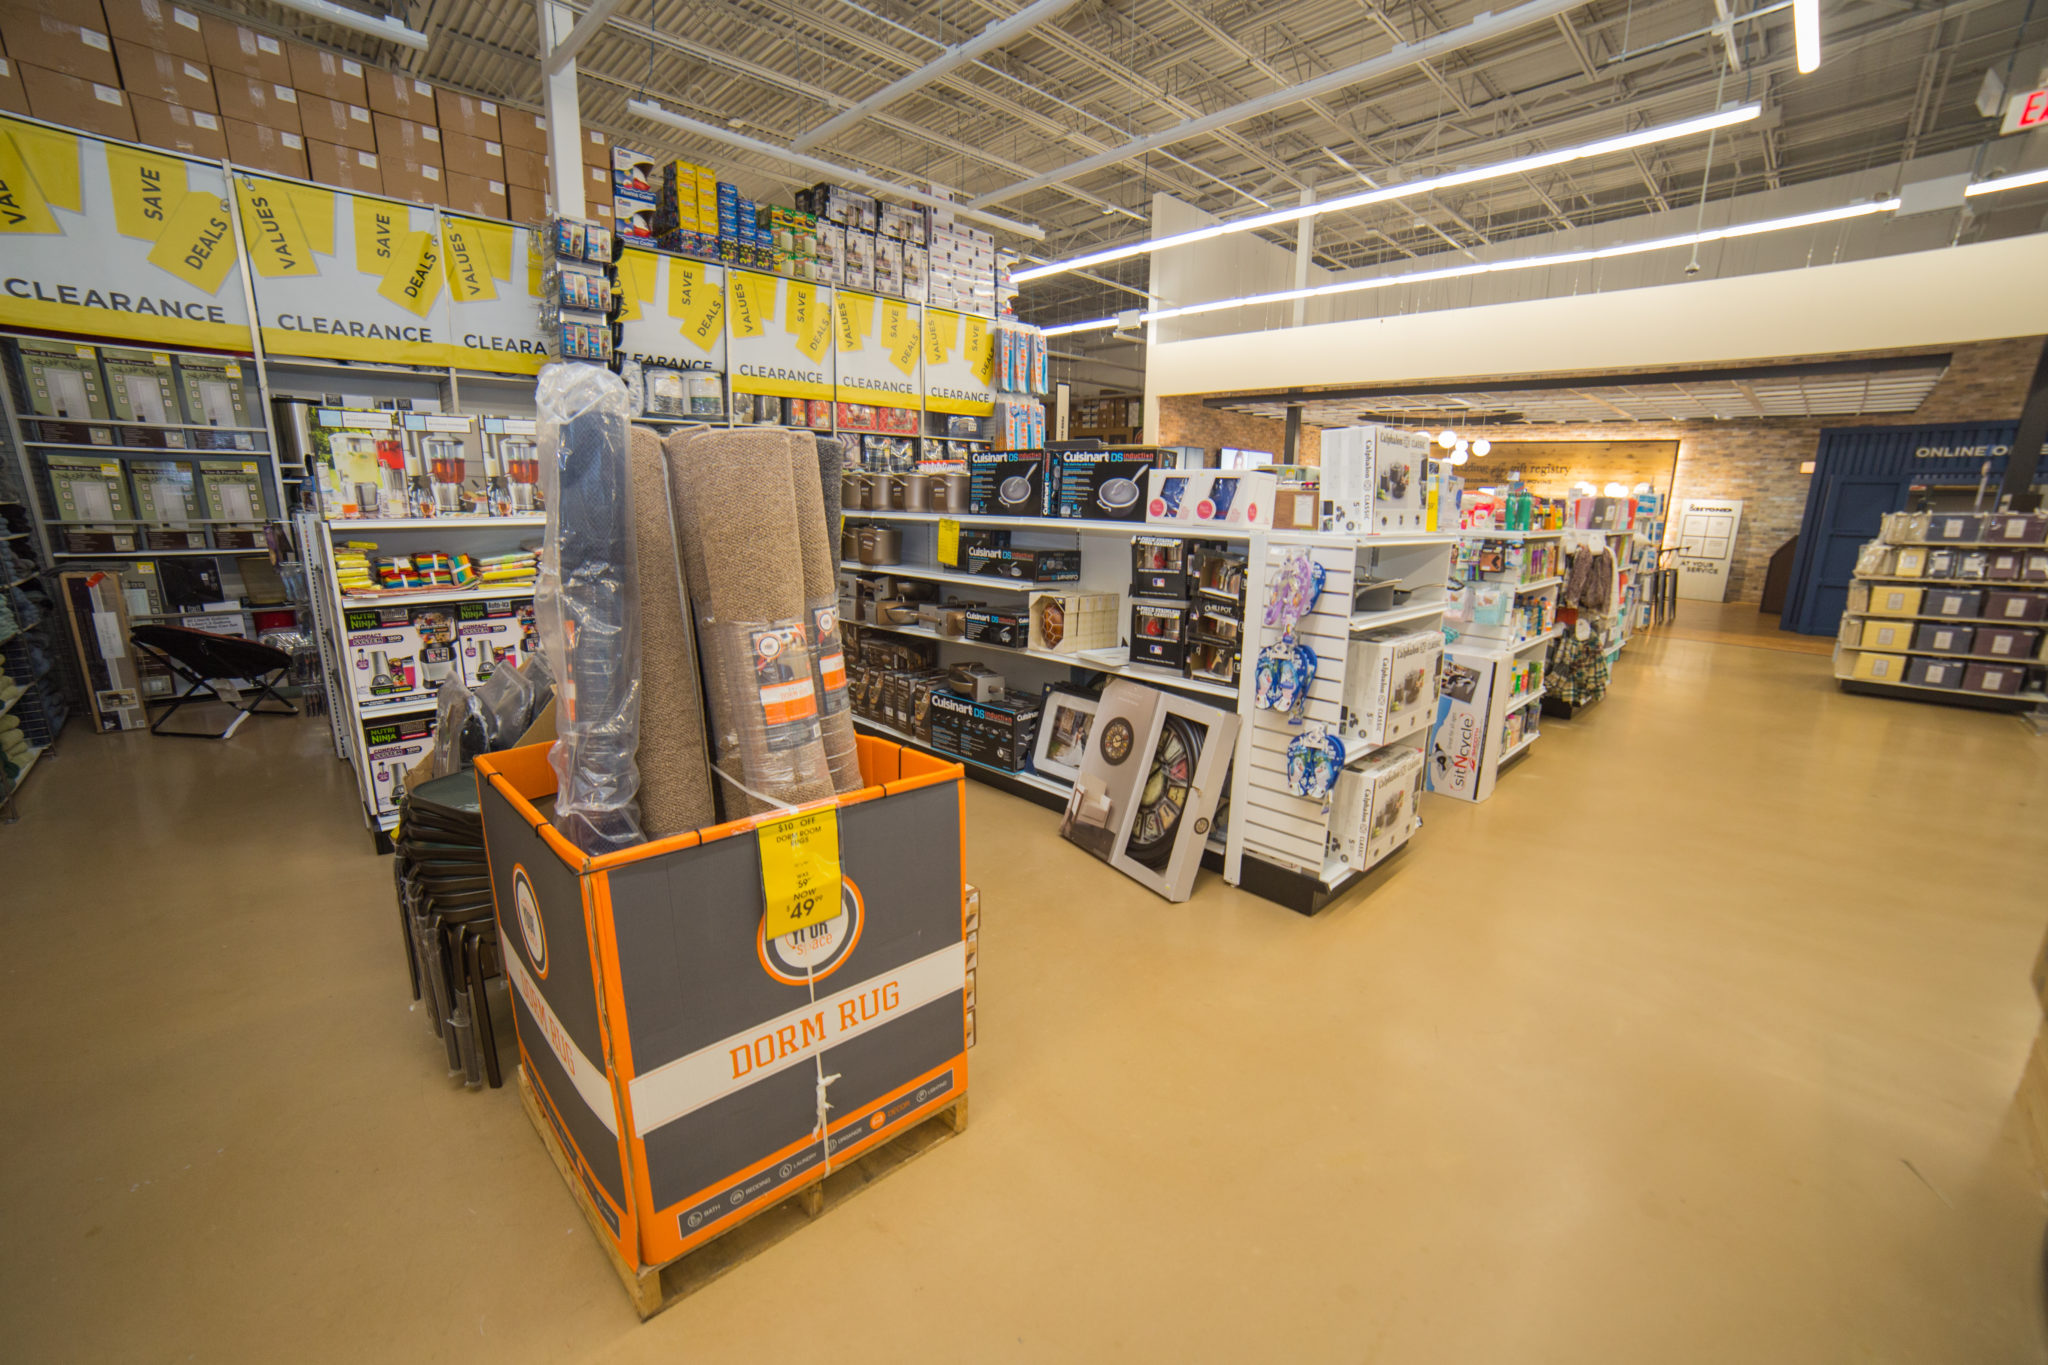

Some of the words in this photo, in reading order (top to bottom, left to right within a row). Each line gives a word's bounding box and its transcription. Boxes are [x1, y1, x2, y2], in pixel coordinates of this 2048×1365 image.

[140, 167, 163, 221] SAVE
[184, 218, 228, 270] DEALS
[252, 197, 296, 269] VALUES
[376, 214, 390, 258] SAVE
[404, 252, 437, 298] DEALS
[451, 233, 480, 296] VALUES
[4, 278, 226, 324] CLEARANCE
[681, 270, 693, 305] SAVE
[698, 301, 722, 337] DEALS
[735, 284, 754, 333] VALUES
[797, 292, 806, 322] SAVE
[278, 314, 432, 343] CLEARANCE
[809, 319, 829, 351] DEALS
[839, 302, 853, 348] VALUES
[890, 310, 899, 338] SAVE
[464, 334, 548, 355] CLEARA
[901, 335, 918, 365] DEALS
[928, 320, 940, 360] VALUES
[740, 365, 823, 384] CLEARANCE
[980, 348, 994, 376] DEAL
[843, 376, 912, 394] CLEARANCE
[931, 387, 989, 403] CLEARANCE
[972, 452, 1008, 463] Cuisinart
[1009, 453, 1019, 462] DS
[1063, 451, 1109, 463] Cuisinart
[1110, 452, 1123, 462] DS
[1916, 446, 1985, 457] ONLINE
[1530, 464, 1569, 476] registry
[968, 546, 1001, 559] Cuisinart
[1003, 550, 1011, 559] DS
[351, 620, 377, 629] NINJA
[966, 612, 990, 622] Cuisinart
[1381, 658, 1389, 693] Calphalon
[932, 695, 972, 716] Cuisinart
[974, 707, 985, 719] DS
[1017, 711, 1039, 721] Cuisinar
[371, 727, 396, 735] NUTRI
[372, 734, 397, 744] NINJA
[1361, 789, 1371, 822] Calphalon
[778, 822, 794, 832] $10
[800, 817, 815, 826] OFF
[800, 826, 821, 836] ROOM
[794, 888, 816, 900] NOW
[520, 968, 548, 1032] DORM
[548, 1015, 575, 1075] RUG
[729, 1011, 826, 1080] DORM
[838, 980, 899, 1032] RUG
[704, 1204, 720, 1217] BATH
[745, 1177, 771, 1195] BEDDING
[793, 1152, 817, 1168] LAUNDRY
